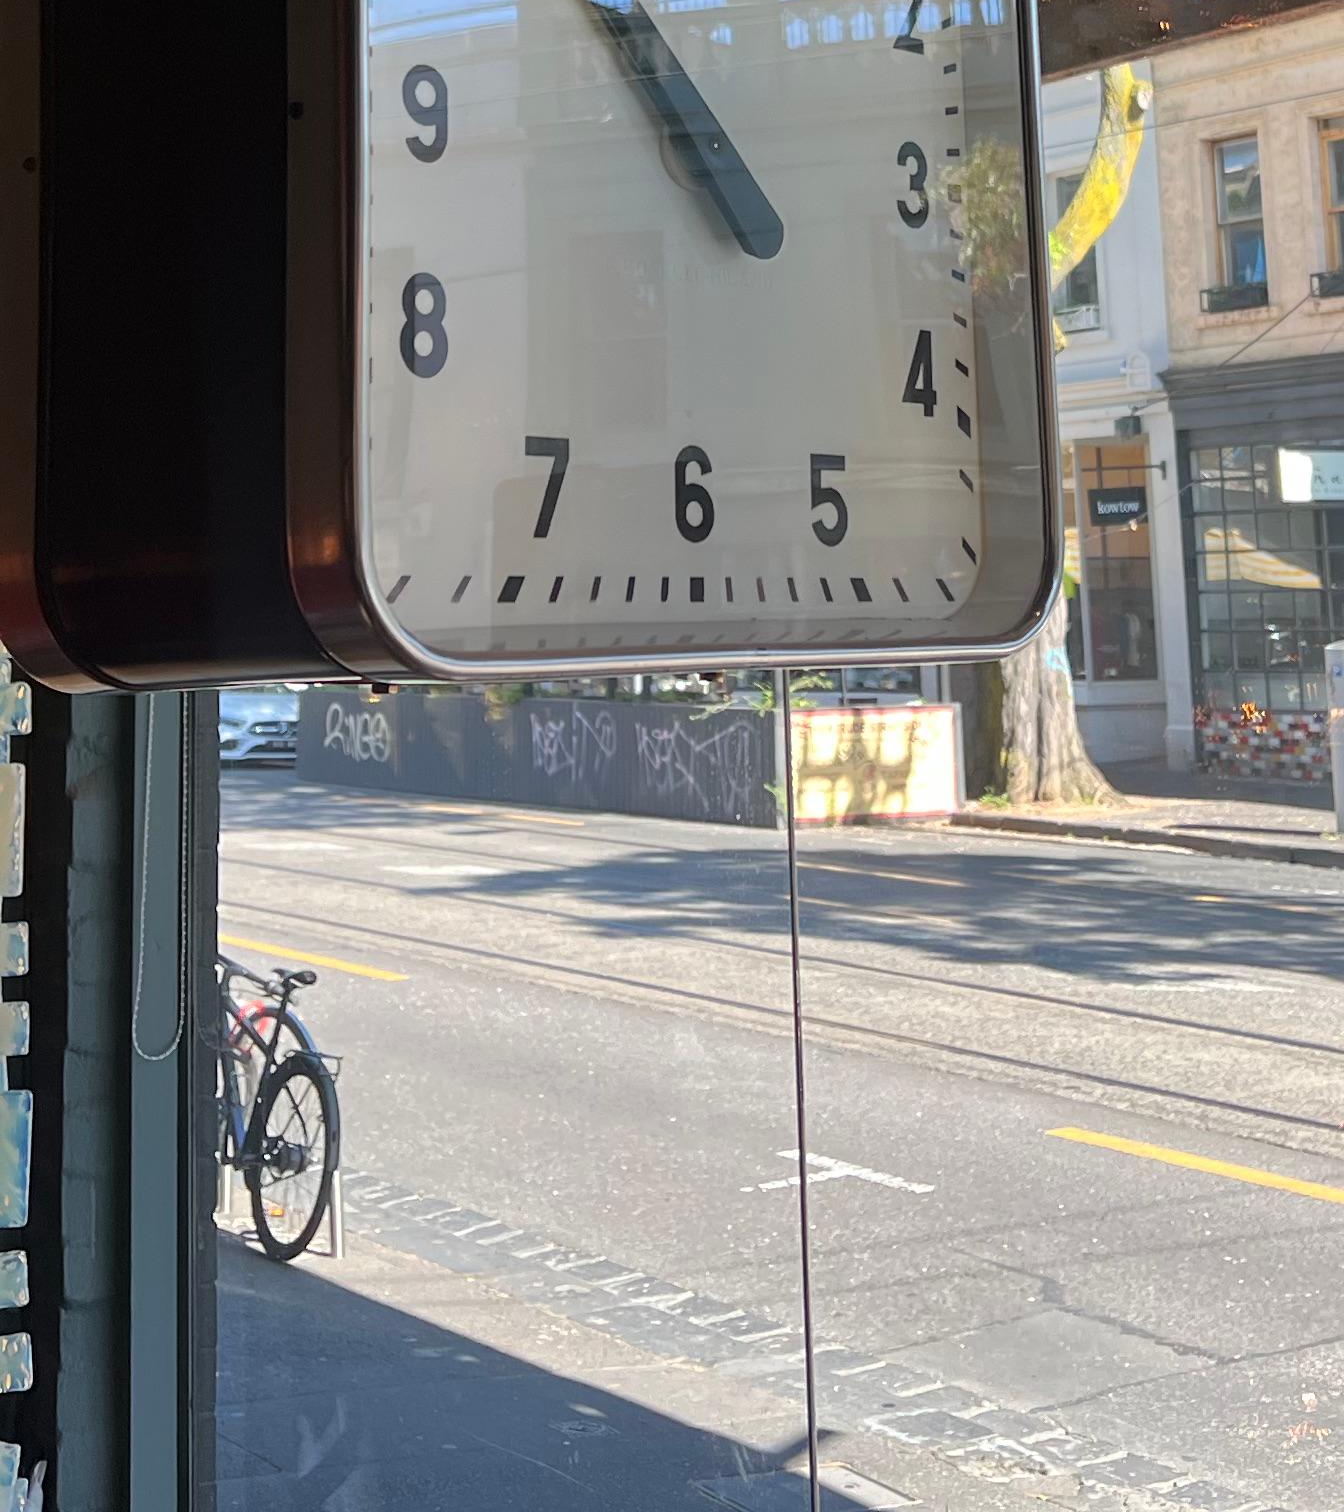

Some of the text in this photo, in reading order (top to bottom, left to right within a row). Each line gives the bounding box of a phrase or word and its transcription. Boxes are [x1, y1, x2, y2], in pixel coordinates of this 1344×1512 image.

[401, 64, 450, 164] 9
[895, 140, 931, 230] 3
[398, 272, 450, 379] 8
[901, 329, 938, 418] 4
[524, 435, 570, 539] 7
[674, 444, 715, 544] 6
[809, 452, 850, 549] 5
